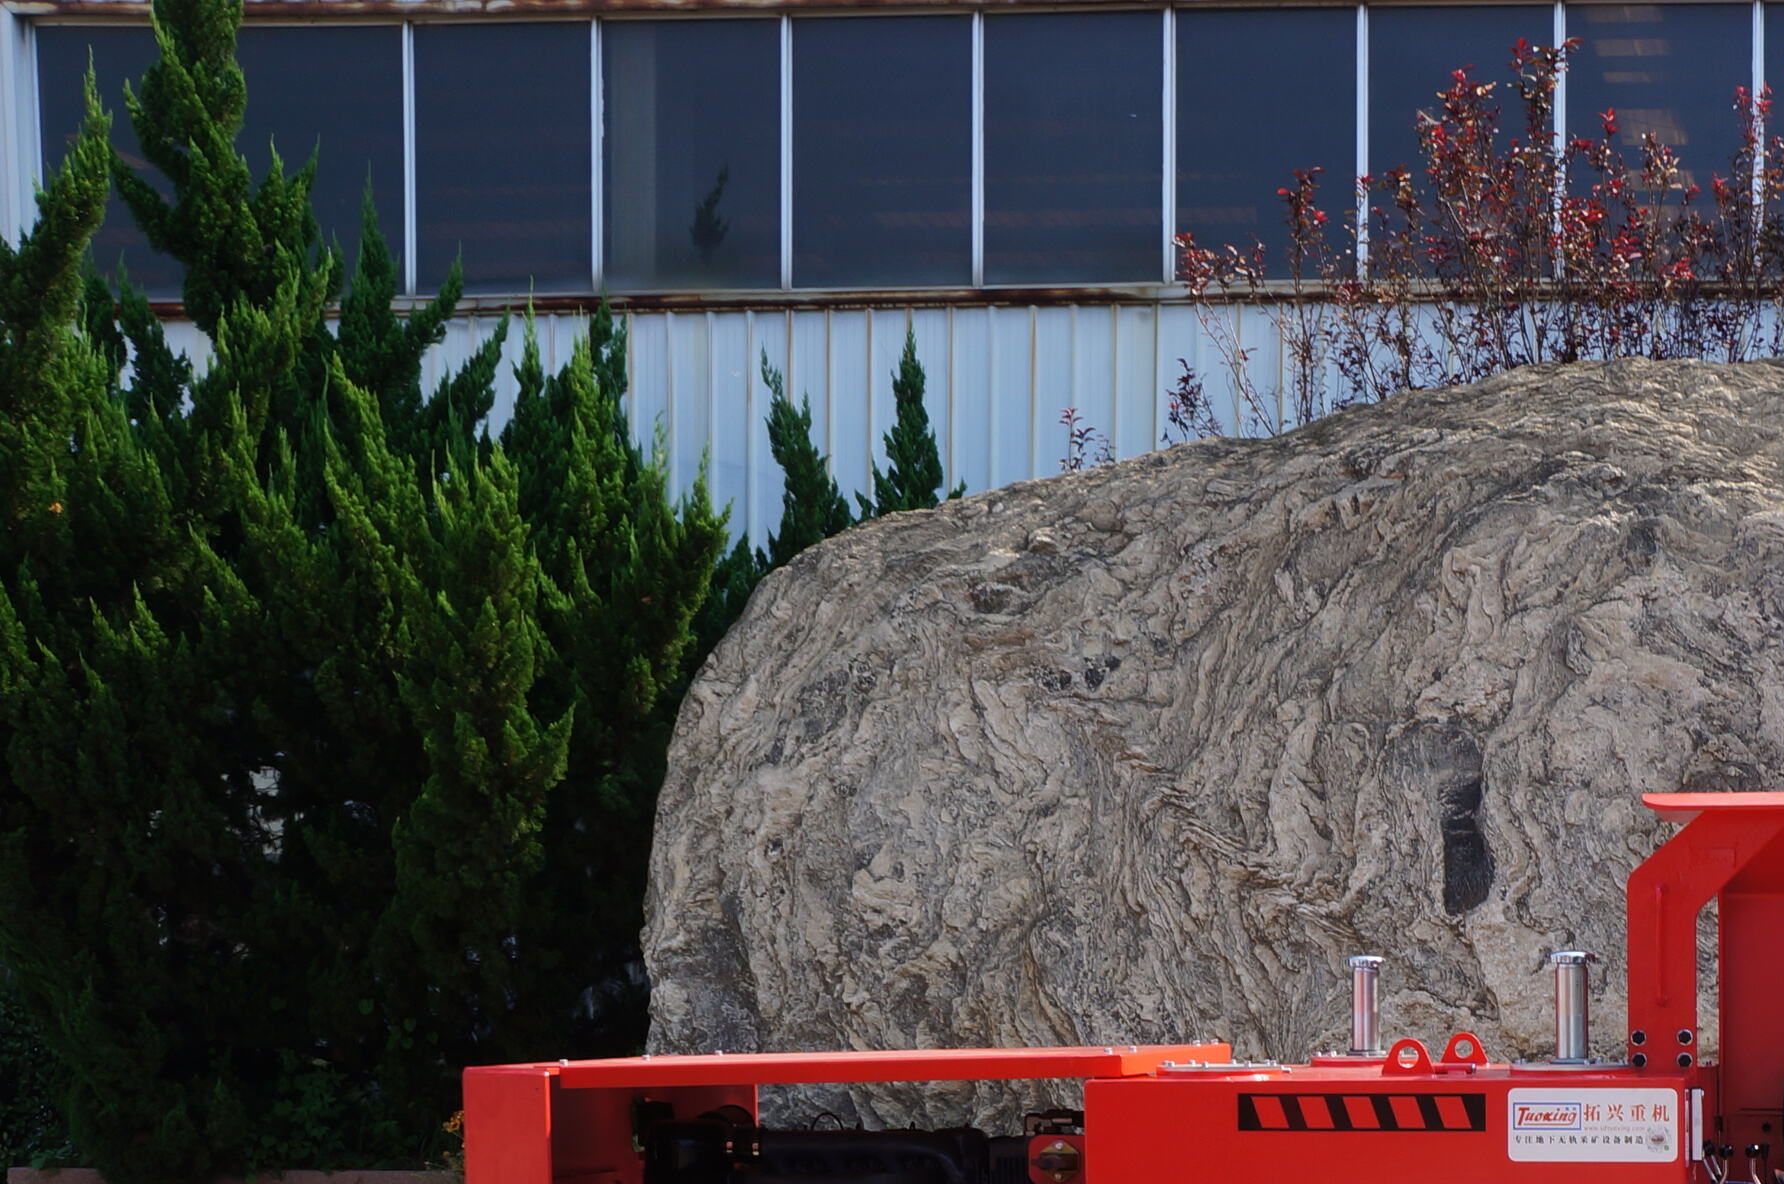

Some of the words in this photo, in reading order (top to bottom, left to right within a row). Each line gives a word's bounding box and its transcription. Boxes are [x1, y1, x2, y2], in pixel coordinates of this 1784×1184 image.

[1517, 1107, 1577, 1126] Tuoxing
[1583, 1104, 1670, 1122] 拓兴重机
